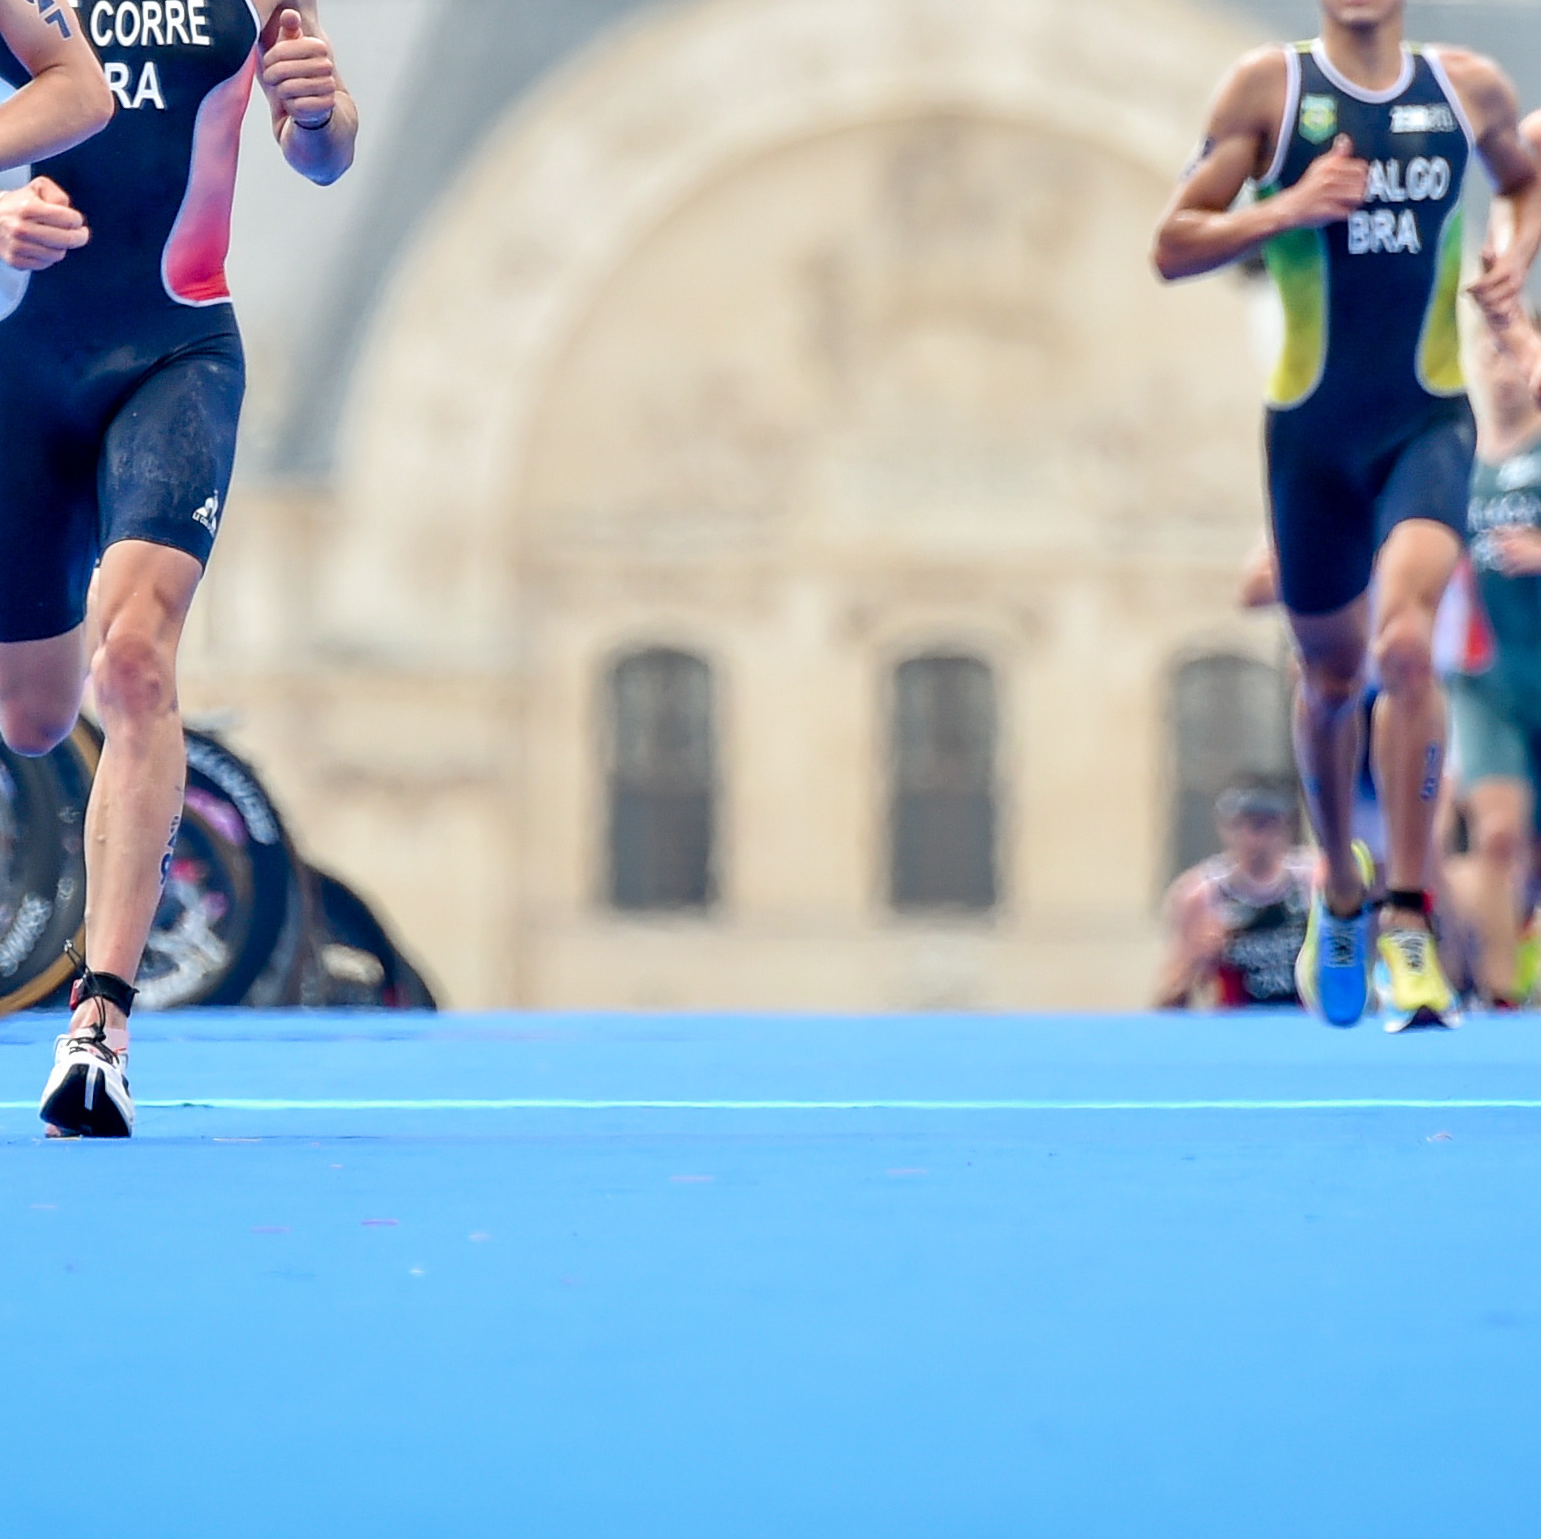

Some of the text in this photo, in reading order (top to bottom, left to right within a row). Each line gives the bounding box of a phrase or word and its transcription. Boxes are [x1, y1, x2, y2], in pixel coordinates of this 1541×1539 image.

[104, 62, 165, 110] RA
[1367, 156, 1451, 203] ALGO
[1348, 209, 1421, 254] BRA
